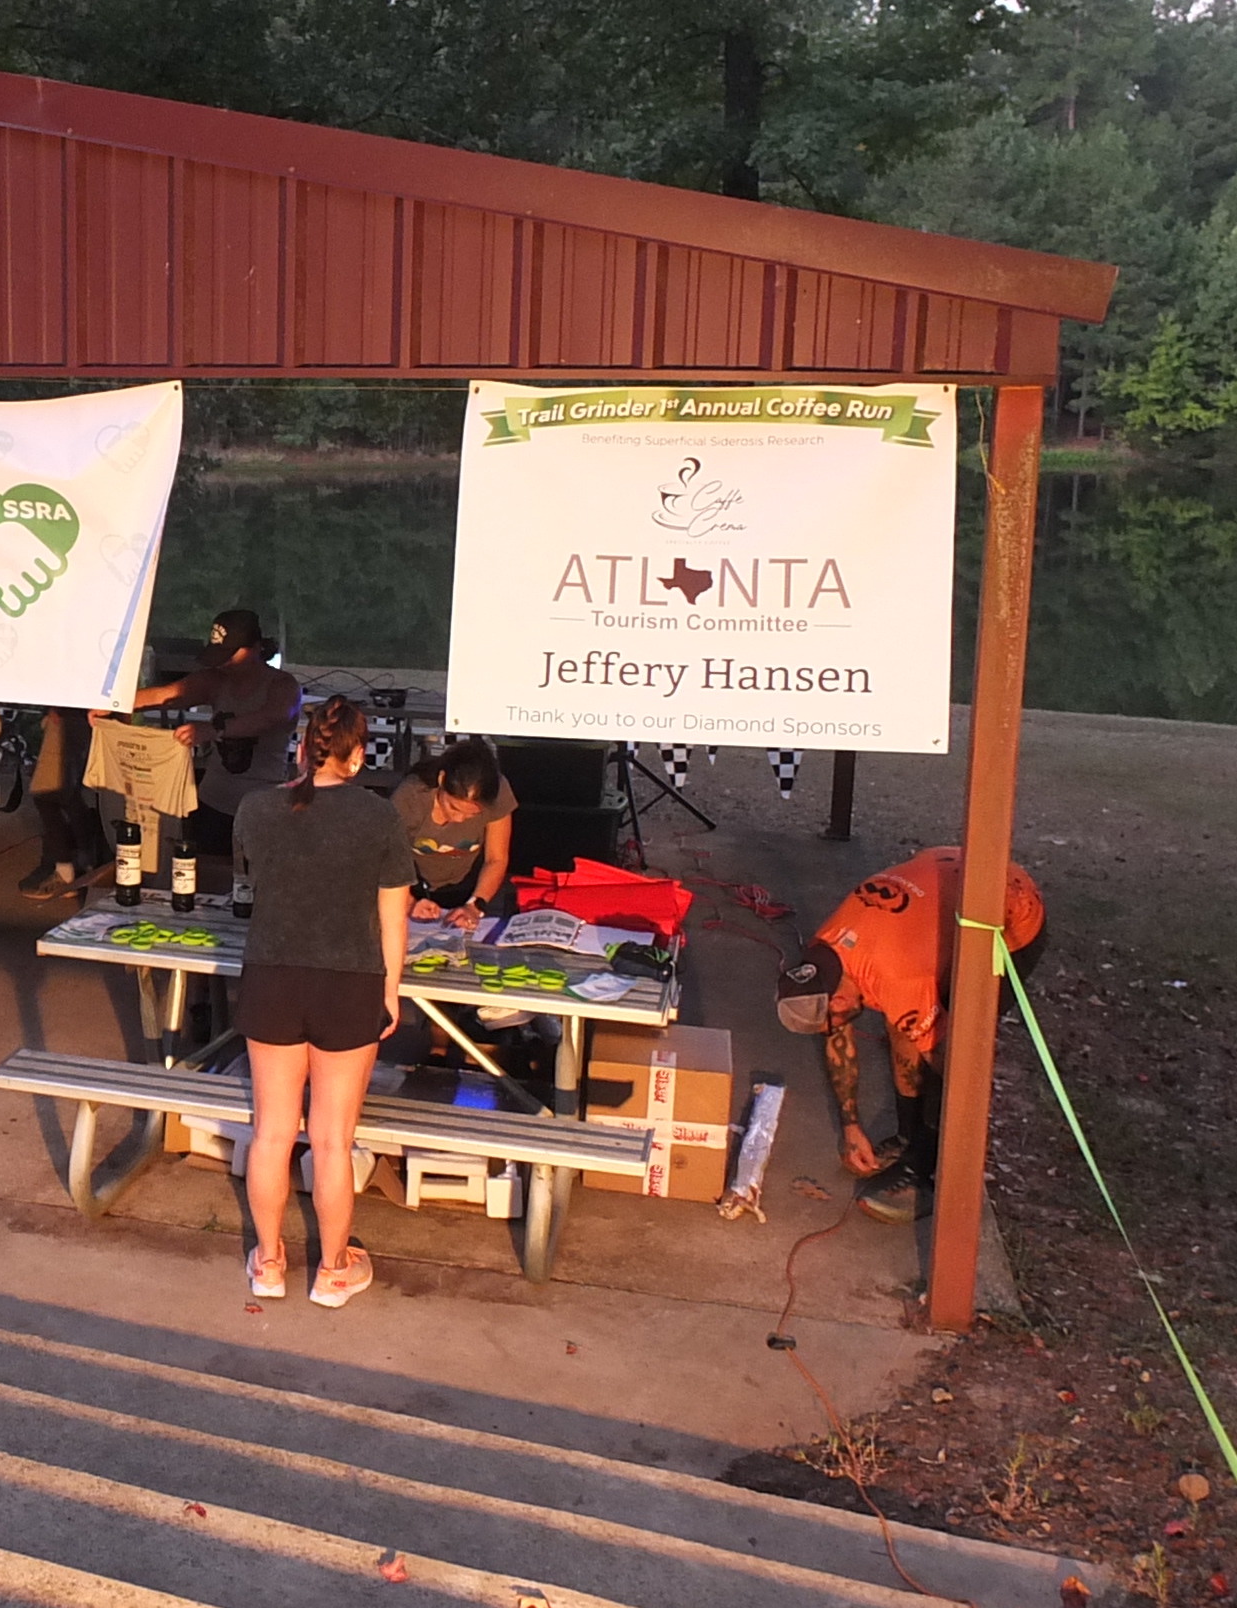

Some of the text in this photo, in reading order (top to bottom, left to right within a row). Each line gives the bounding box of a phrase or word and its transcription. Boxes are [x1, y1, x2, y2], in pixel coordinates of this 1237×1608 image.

[517, 397, 893, 426] Trail Grinder 1st Annual Coffee Run
[582, 433, 825, 447] Benefiting Superficial Siderosis Research
[3, 500, 72, 522] SSRA
[552, 553, 852, 610] ATLNTA
[591, 610, 808, 632] Tourism Committee
[538, 650, 873, 698] Jeffery Hansen
[506, 705, 882, 737] Thank you to our Diamond Sponsors
